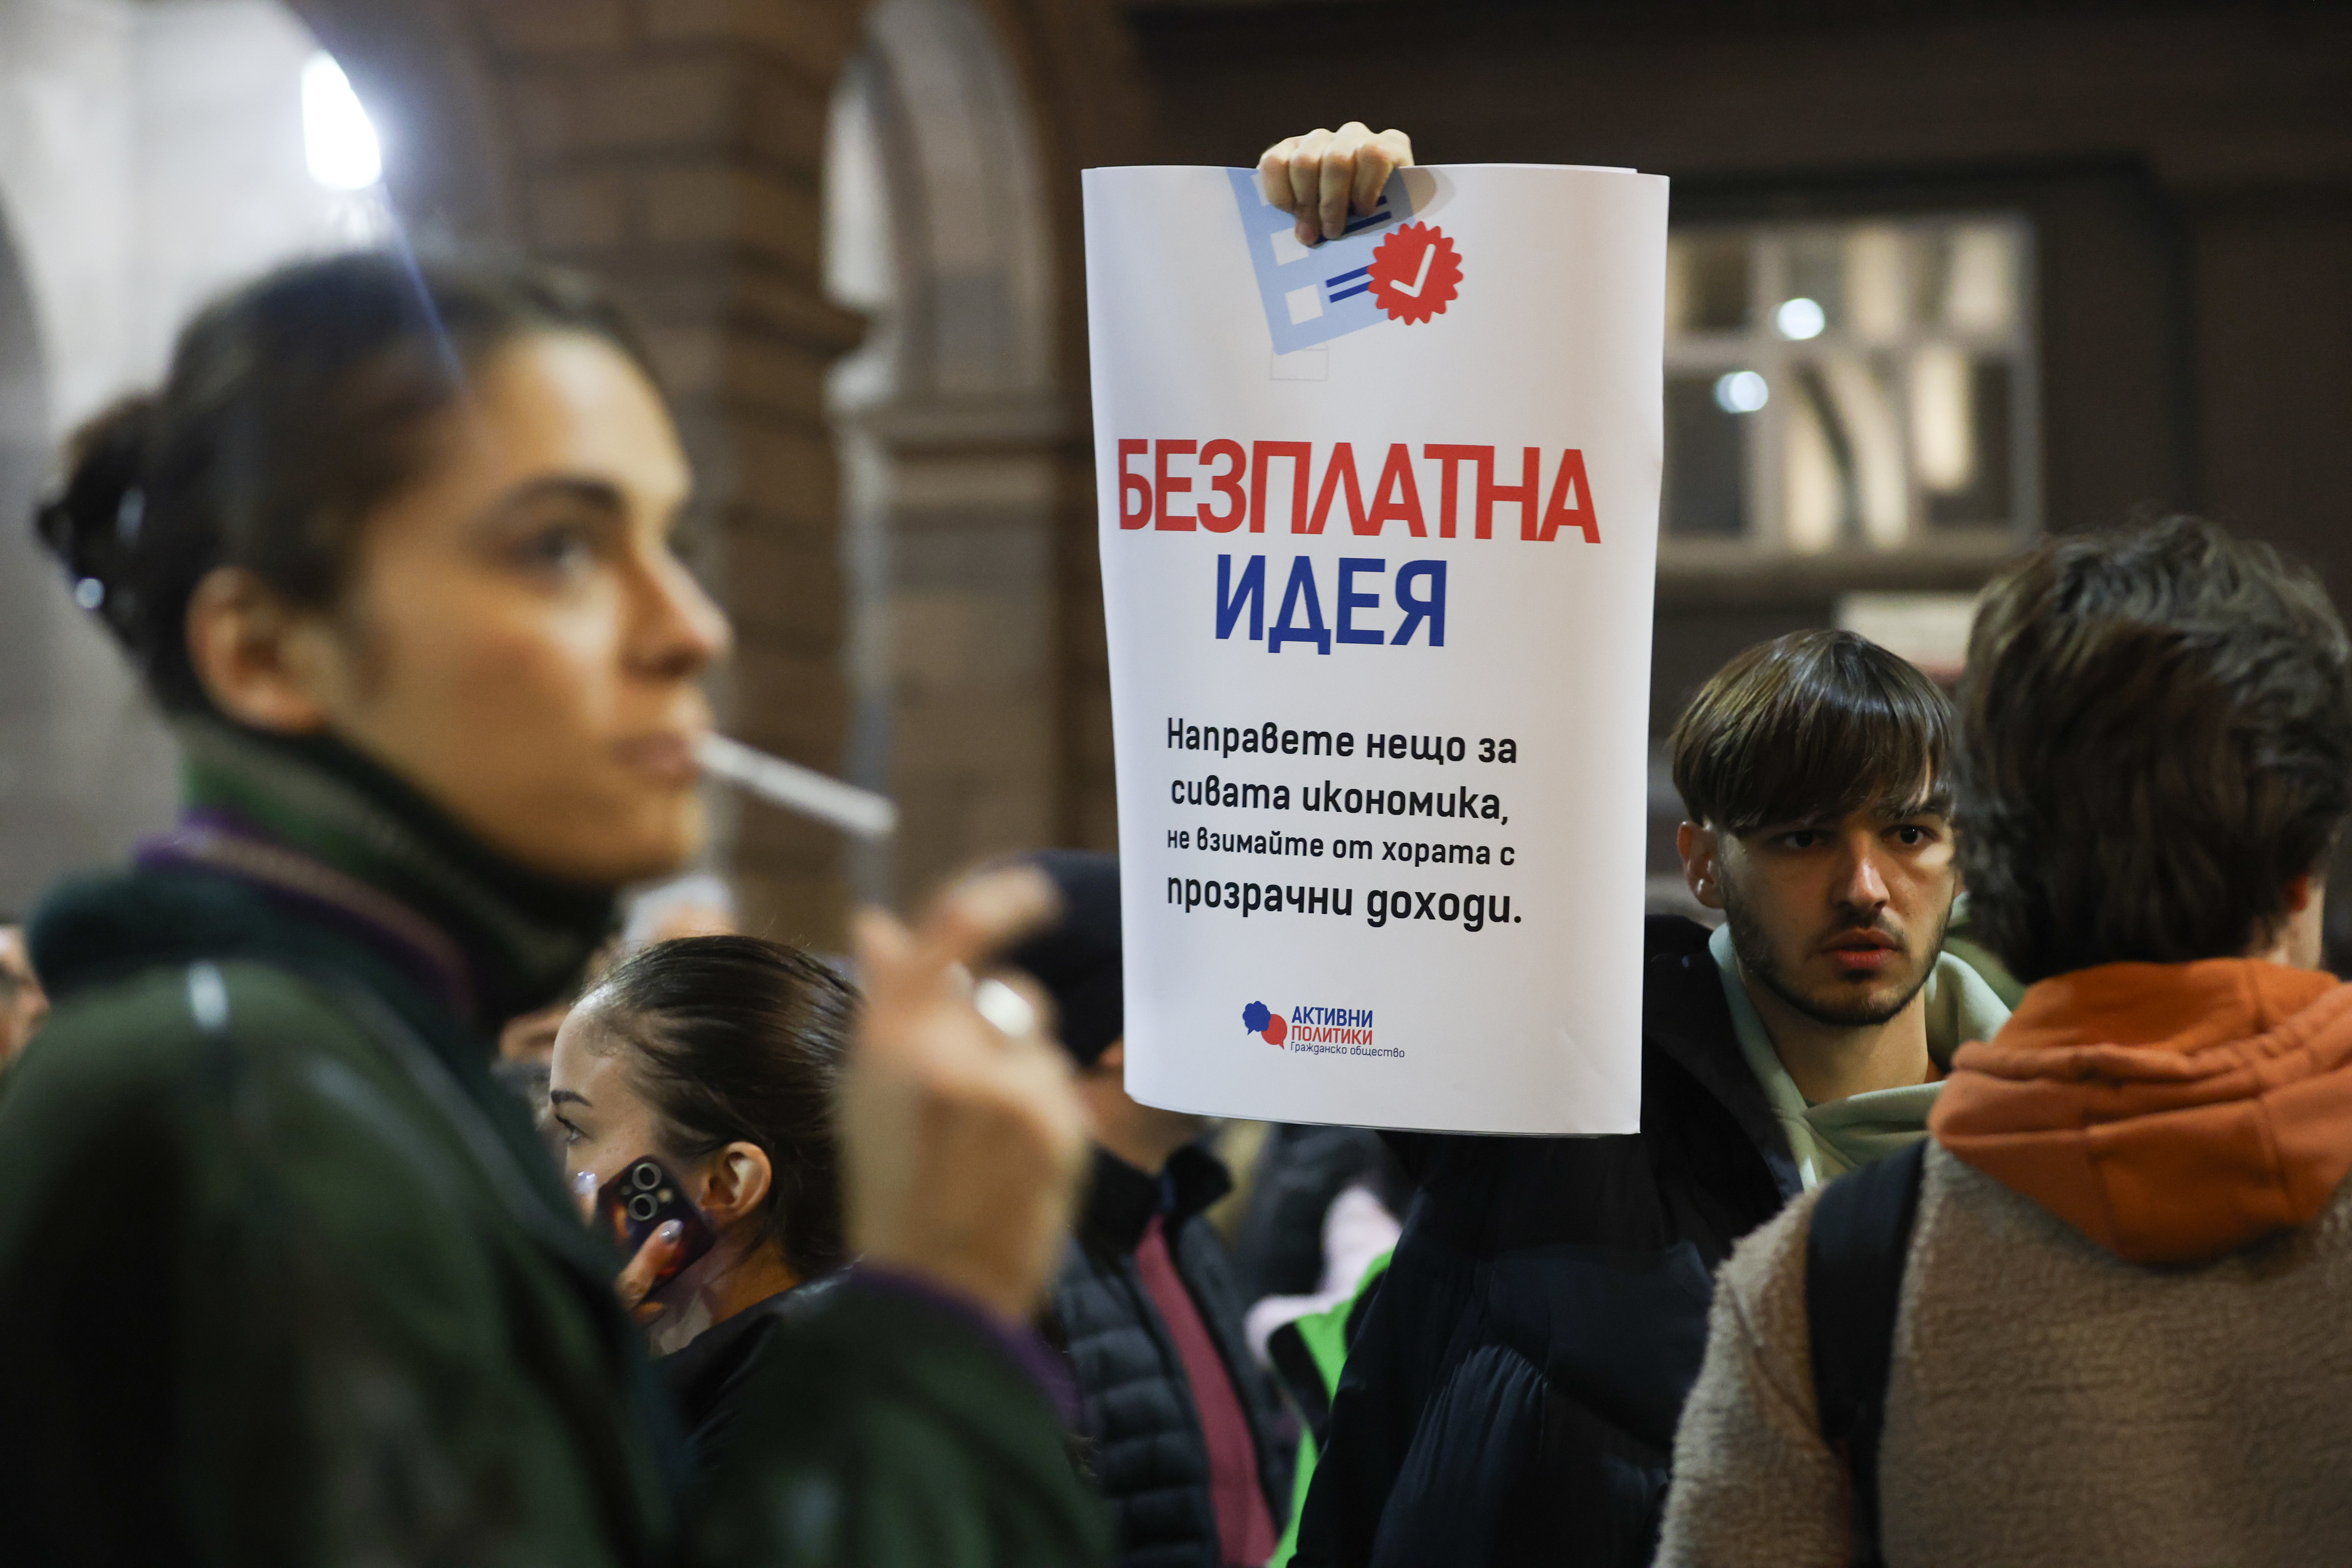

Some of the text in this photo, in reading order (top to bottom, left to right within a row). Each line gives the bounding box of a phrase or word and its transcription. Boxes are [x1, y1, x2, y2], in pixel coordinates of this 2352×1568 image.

[1118, 438, 1601, 544] БЕЗПЛАТНА
[1216, 554, 1447, 655] ИДЕЯ
[1168, 717, 1517, 765] Направете нещо за
[1171, 775, 1508, 826] сивата икономика,
[1168, 827, 1515, 867] не взимайте от хората с
[1168, 877, 1521, 932] прозрачни доходи.
[1291, 1006, 1373, 1028] АКТИВНИ
[1291, 1025, 1372, 1045] ПОЛИТИКИ
[1291, 1041, 1405, 1058] Гражданско общество
